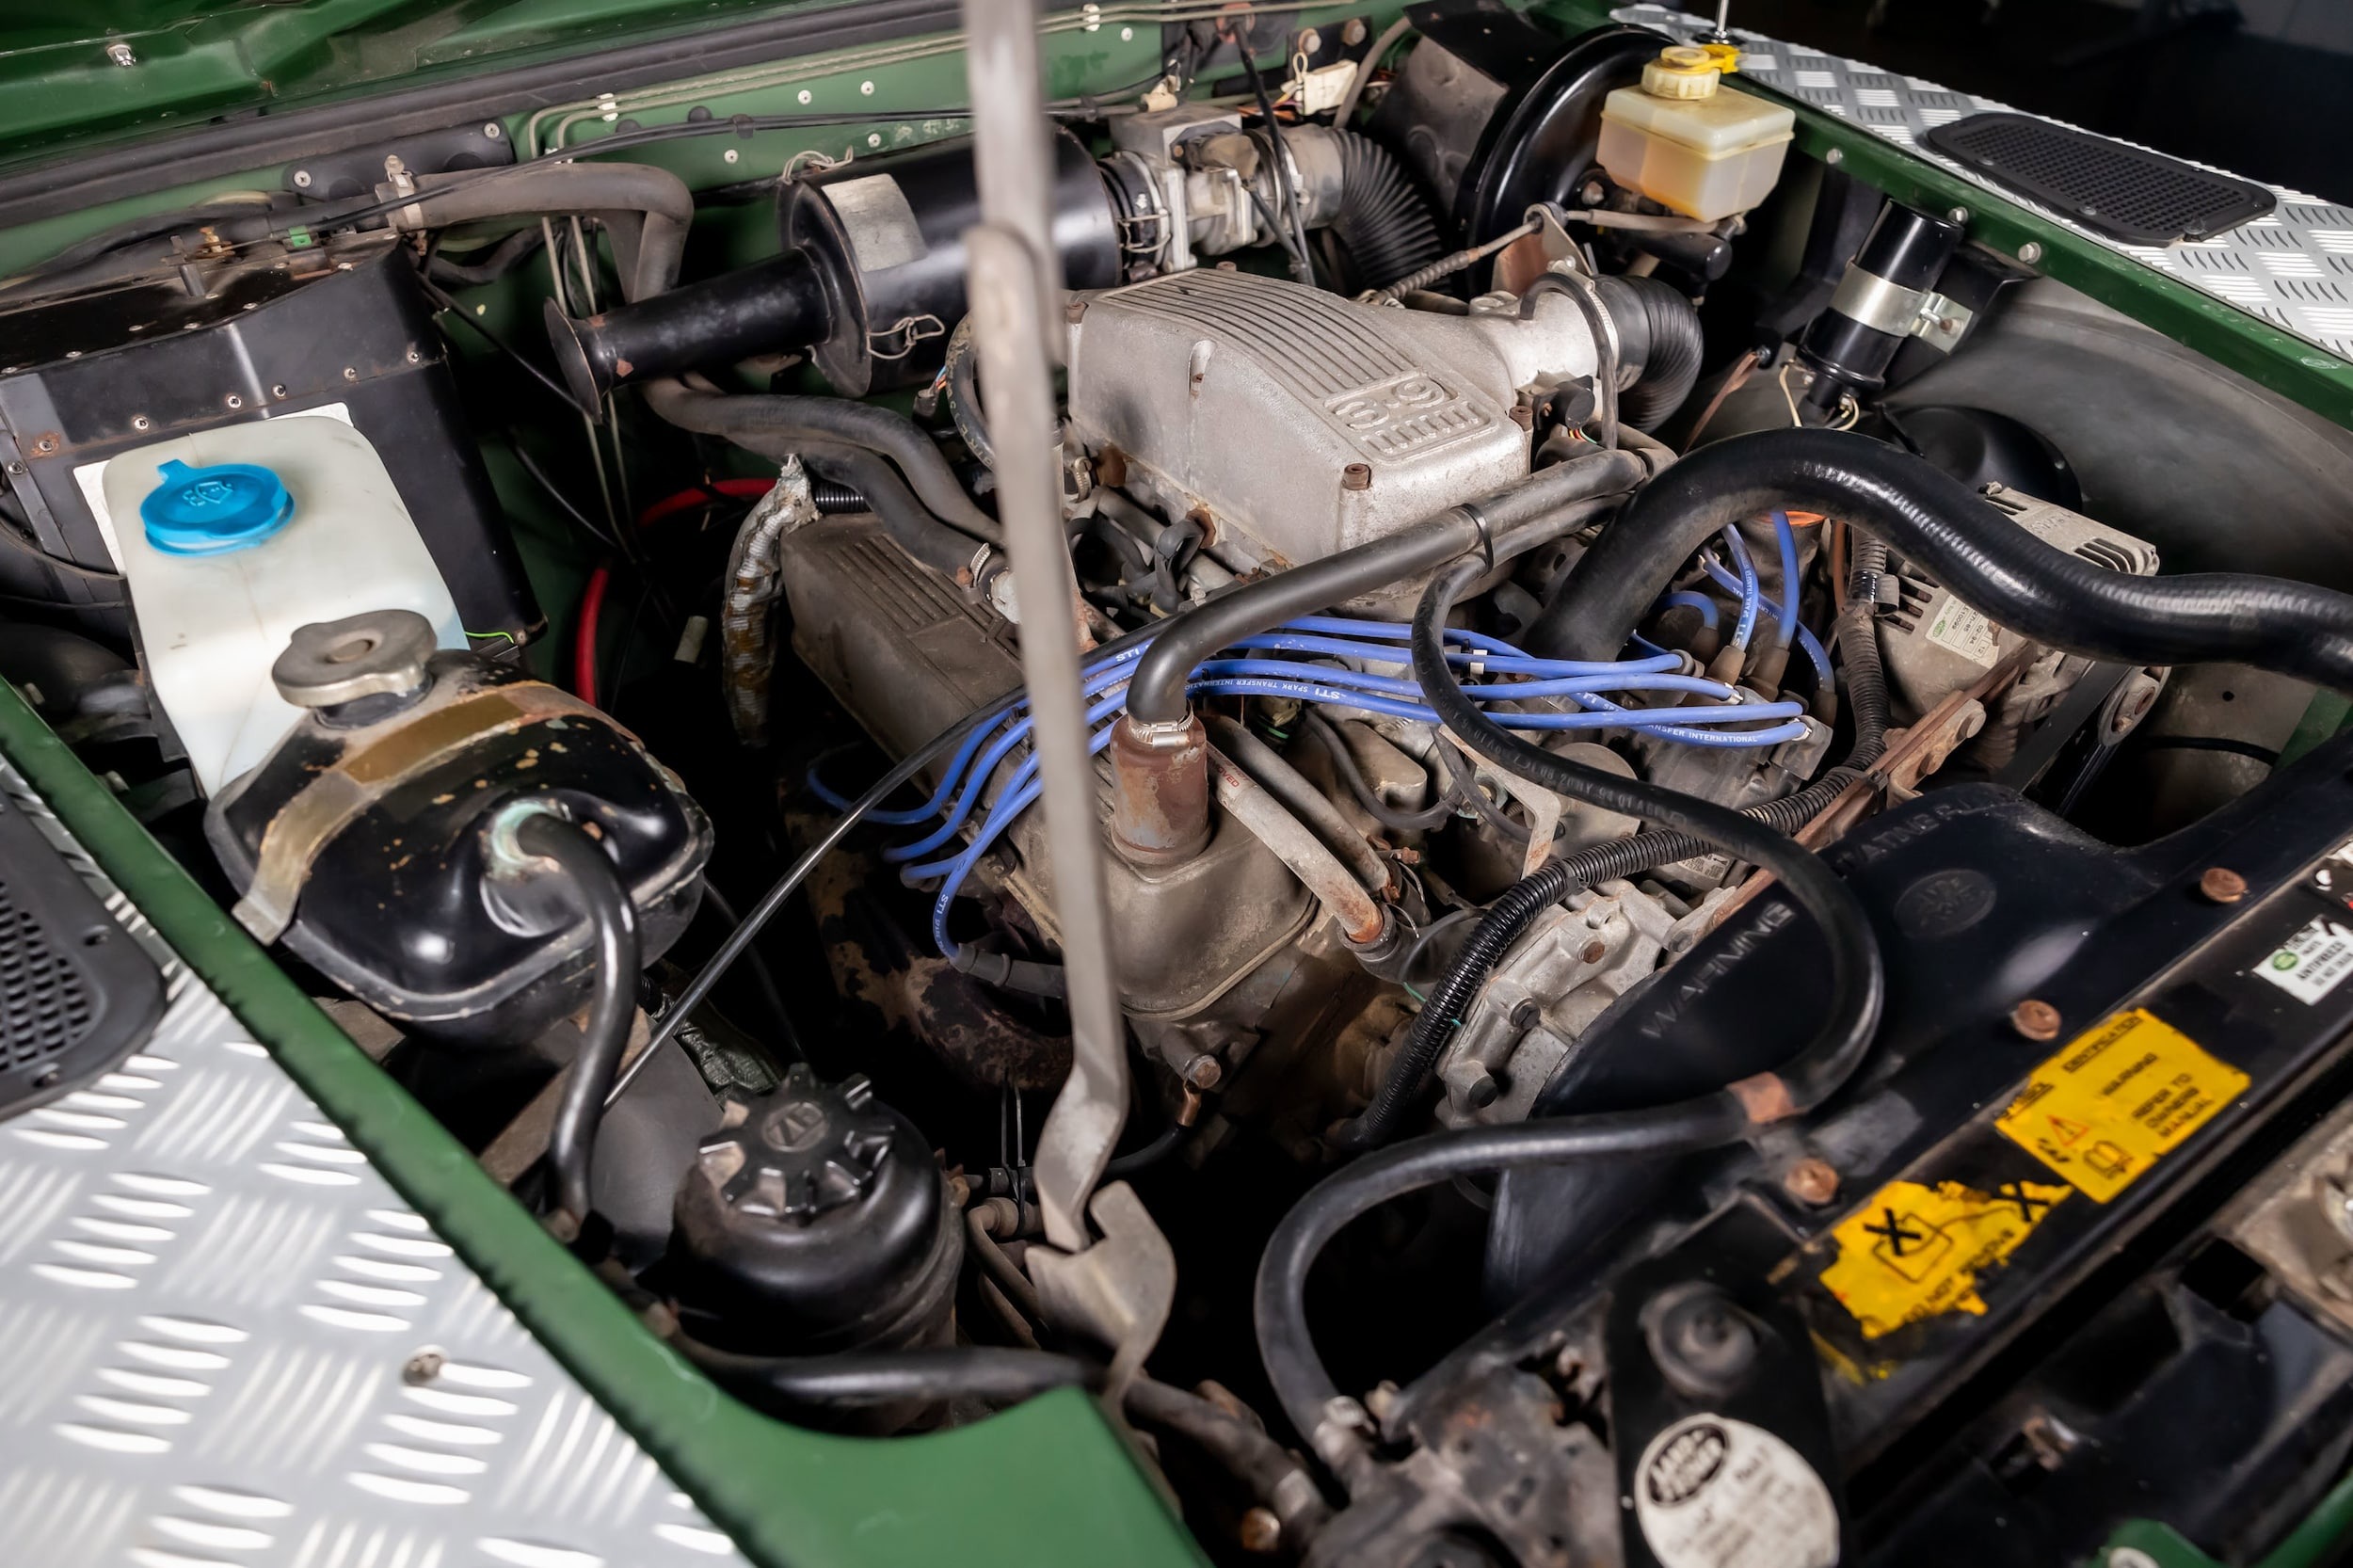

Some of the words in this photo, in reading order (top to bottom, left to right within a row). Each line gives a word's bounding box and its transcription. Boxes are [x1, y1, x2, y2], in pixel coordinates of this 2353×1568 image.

[1332, 376, 1446, 431] 3.9
[1115, 648, 1140, 662] STI
[1236, 679, 1277, 689] TRANSFER
[1282, 681, 1309, 692] SPARK
[1315, 688, 1341, 699] STI
[1689, 731, 1757, 743] INTERNATIONAL
[936, 894, 949, 914] STI
[1641, 900, 1799, 1039] WARNING
[2102, 1052, 2158, 1096] WARNING
